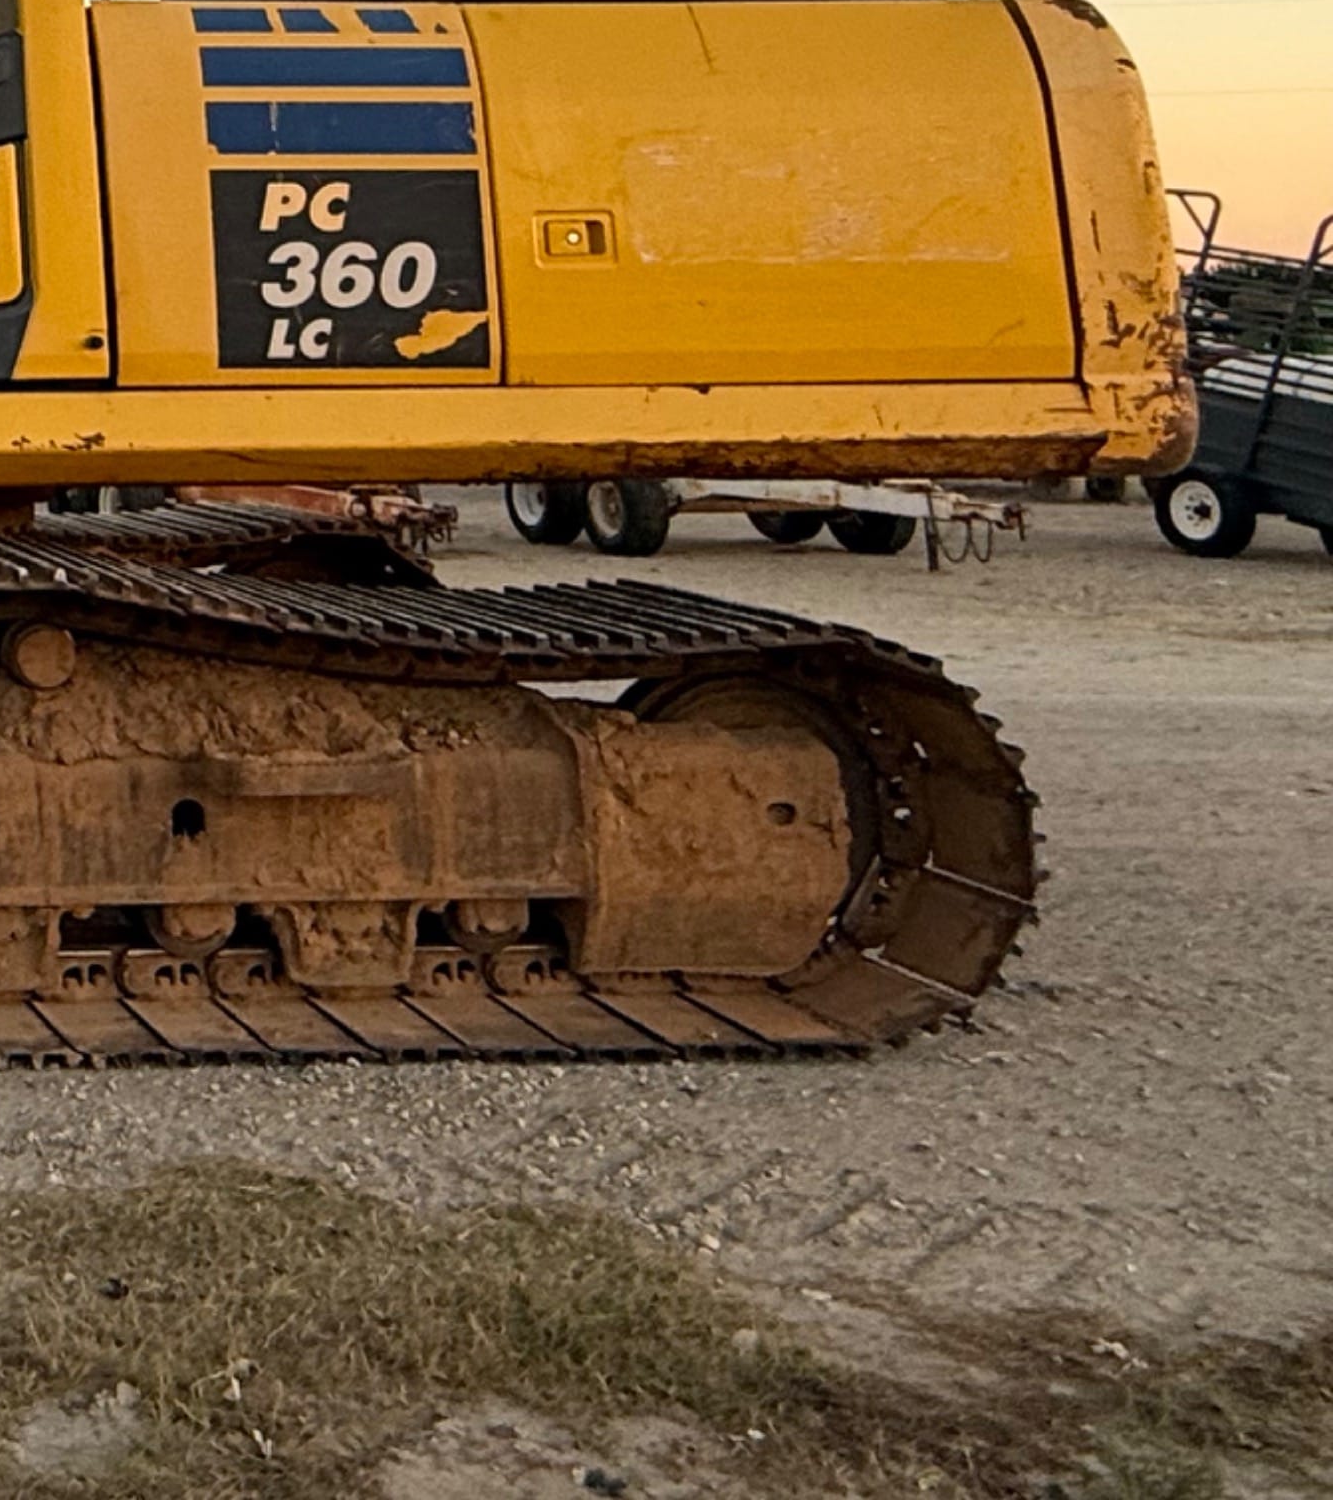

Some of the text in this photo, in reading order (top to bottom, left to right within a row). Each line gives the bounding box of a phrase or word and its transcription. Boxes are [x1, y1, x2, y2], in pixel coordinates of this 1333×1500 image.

[259, 182, 351, 232] PC
[261, 241, 437, 309] 360
[267, 318, 333, 360] LC
